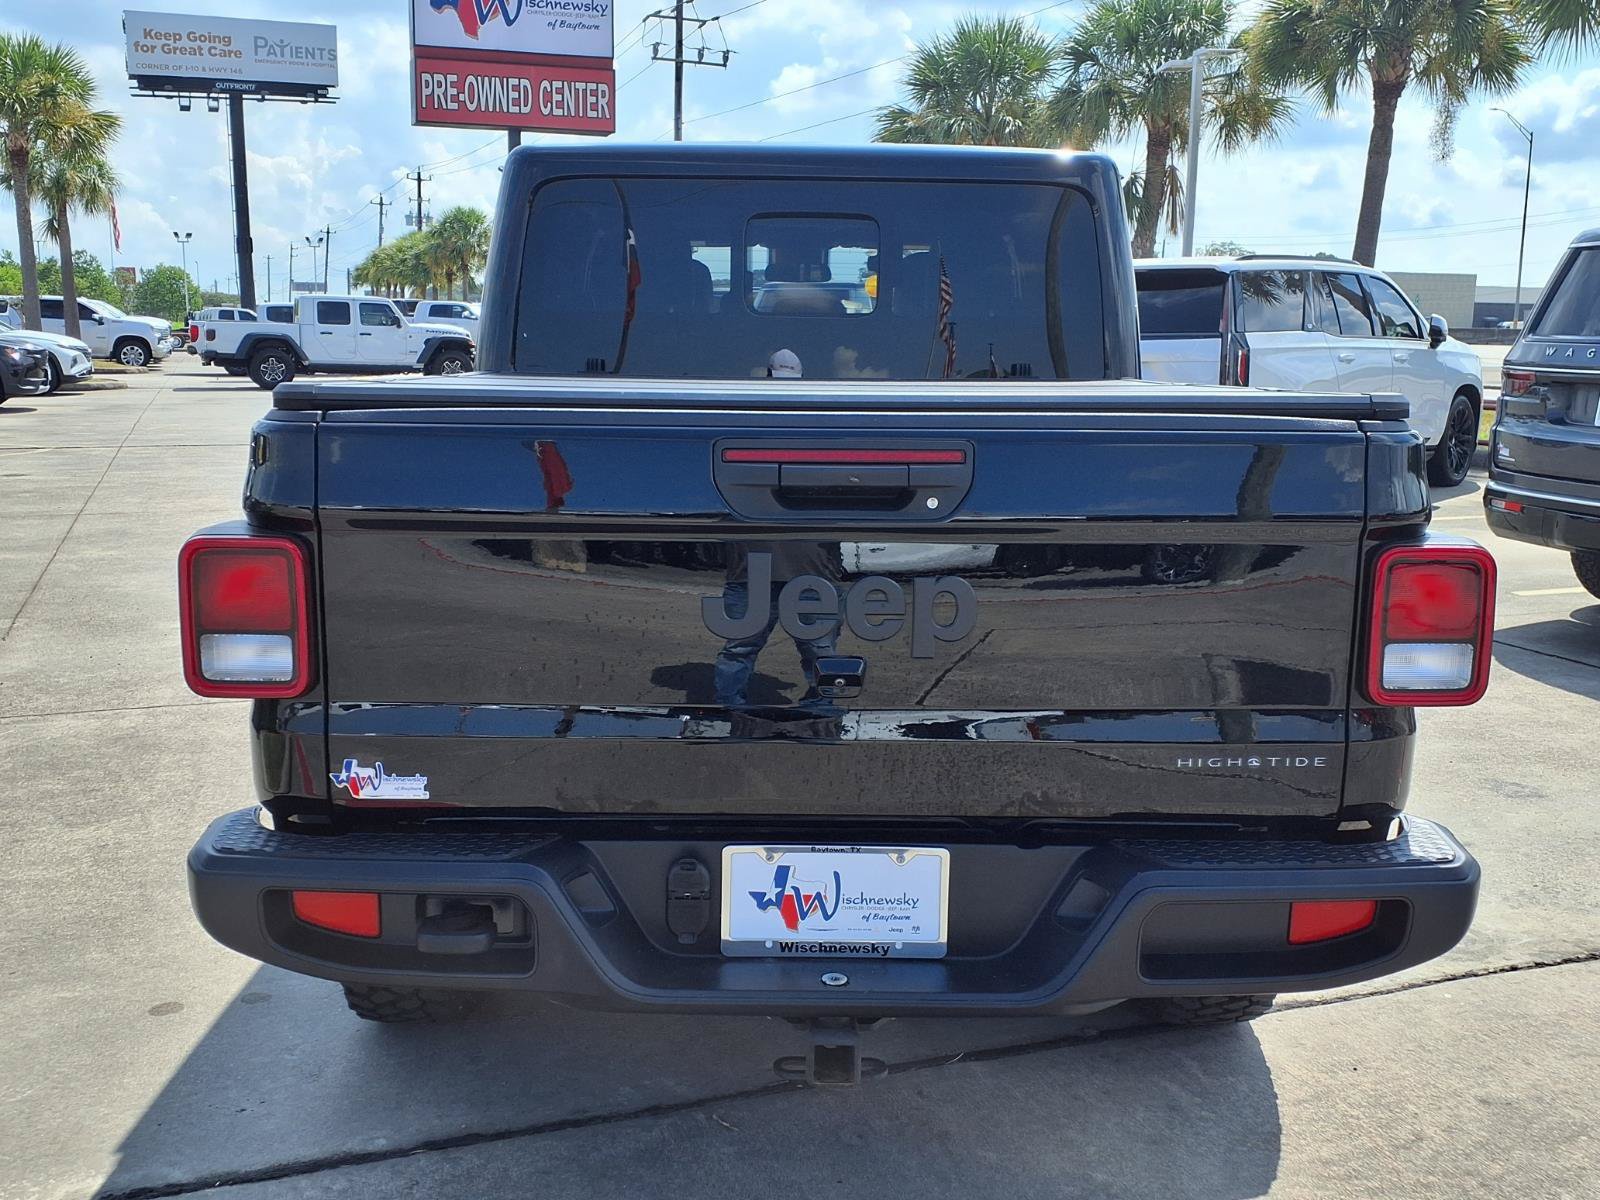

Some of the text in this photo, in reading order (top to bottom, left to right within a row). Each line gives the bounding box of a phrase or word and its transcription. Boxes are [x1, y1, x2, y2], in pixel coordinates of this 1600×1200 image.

[547, 19, 601, 31] of Baytown
[143, 27, 232, 47] Keep Going
[133, 41, 243, 59] for Great Care
[253, 35, 337, 61] PATIENTS
[135, 62, 170, 71] CORNER
[421, 72, 611, 119] PRE-OWNED CENTER
[701, 551, 978, 659] Jeep
[1177, 757, 1327, 768] HIGH TIDE
[791, 870, 920, 922] Wischnewsky
[861, 913, 911, 922] of Baytown
[779, 940, 891, 957] Wischnewsky
